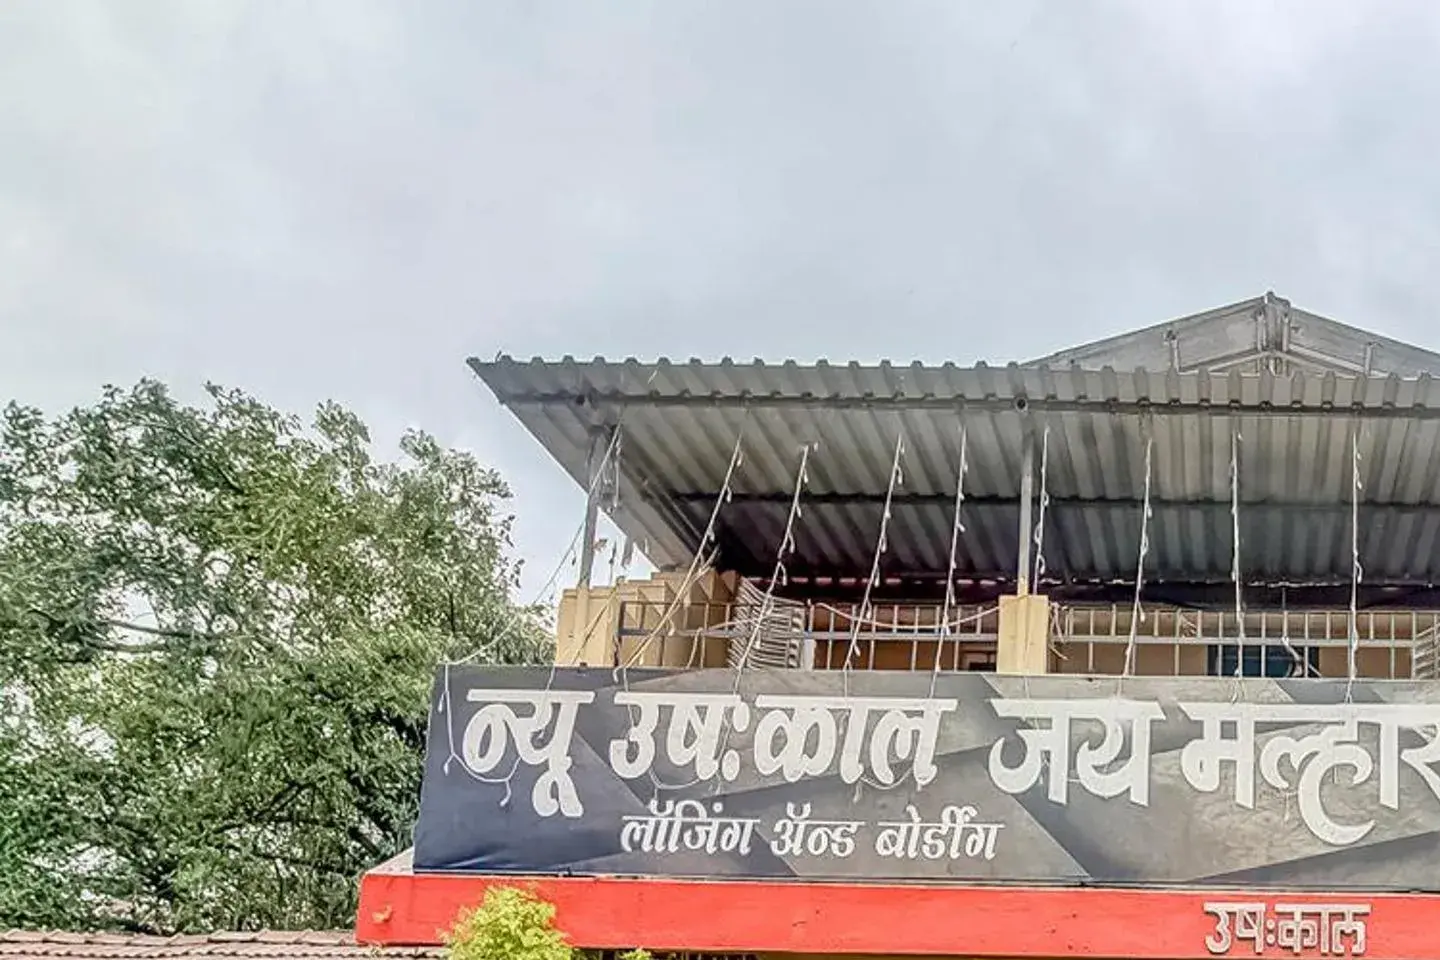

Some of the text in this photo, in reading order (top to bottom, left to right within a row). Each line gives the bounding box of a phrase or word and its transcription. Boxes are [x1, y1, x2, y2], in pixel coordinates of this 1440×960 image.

[462, 689, 596, 818] न्यू
[988, 699, 1166, 807] जय
[619, 799, 760, 854] लॉजिंग
